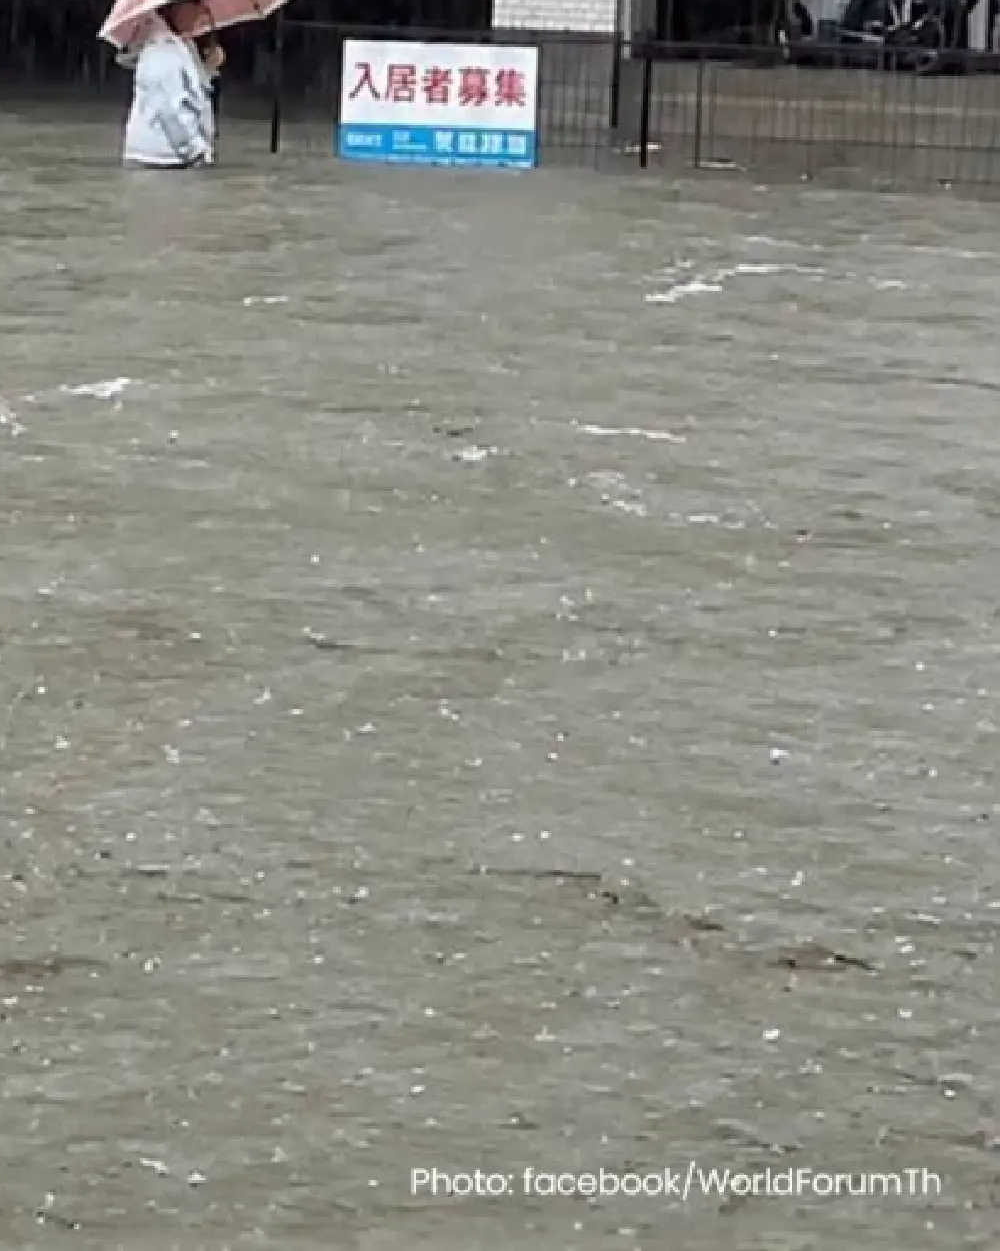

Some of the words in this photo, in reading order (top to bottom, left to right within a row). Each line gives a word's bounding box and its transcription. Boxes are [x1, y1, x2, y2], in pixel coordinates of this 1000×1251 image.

[348, 62, 526, 107] 入居者募集
